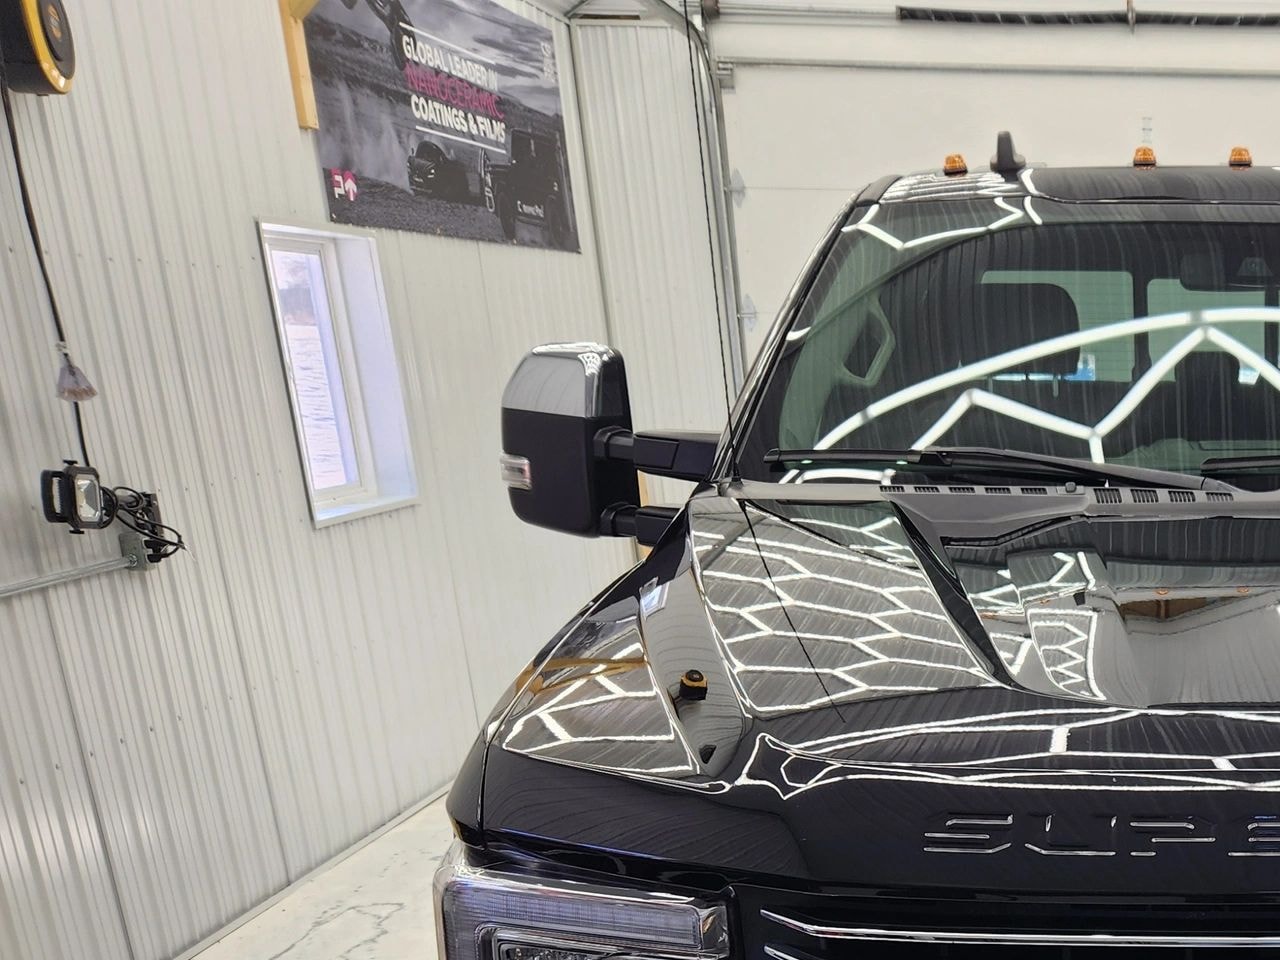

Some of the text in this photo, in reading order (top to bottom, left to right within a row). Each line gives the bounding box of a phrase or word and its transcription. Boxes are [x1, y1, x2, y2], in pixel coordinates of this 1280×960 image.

[402, 35, 449, 73] GLOBAL
[448, 53, 488, 88] LEADER
[411, 94, 506, 143] COATINGS & FILMS
